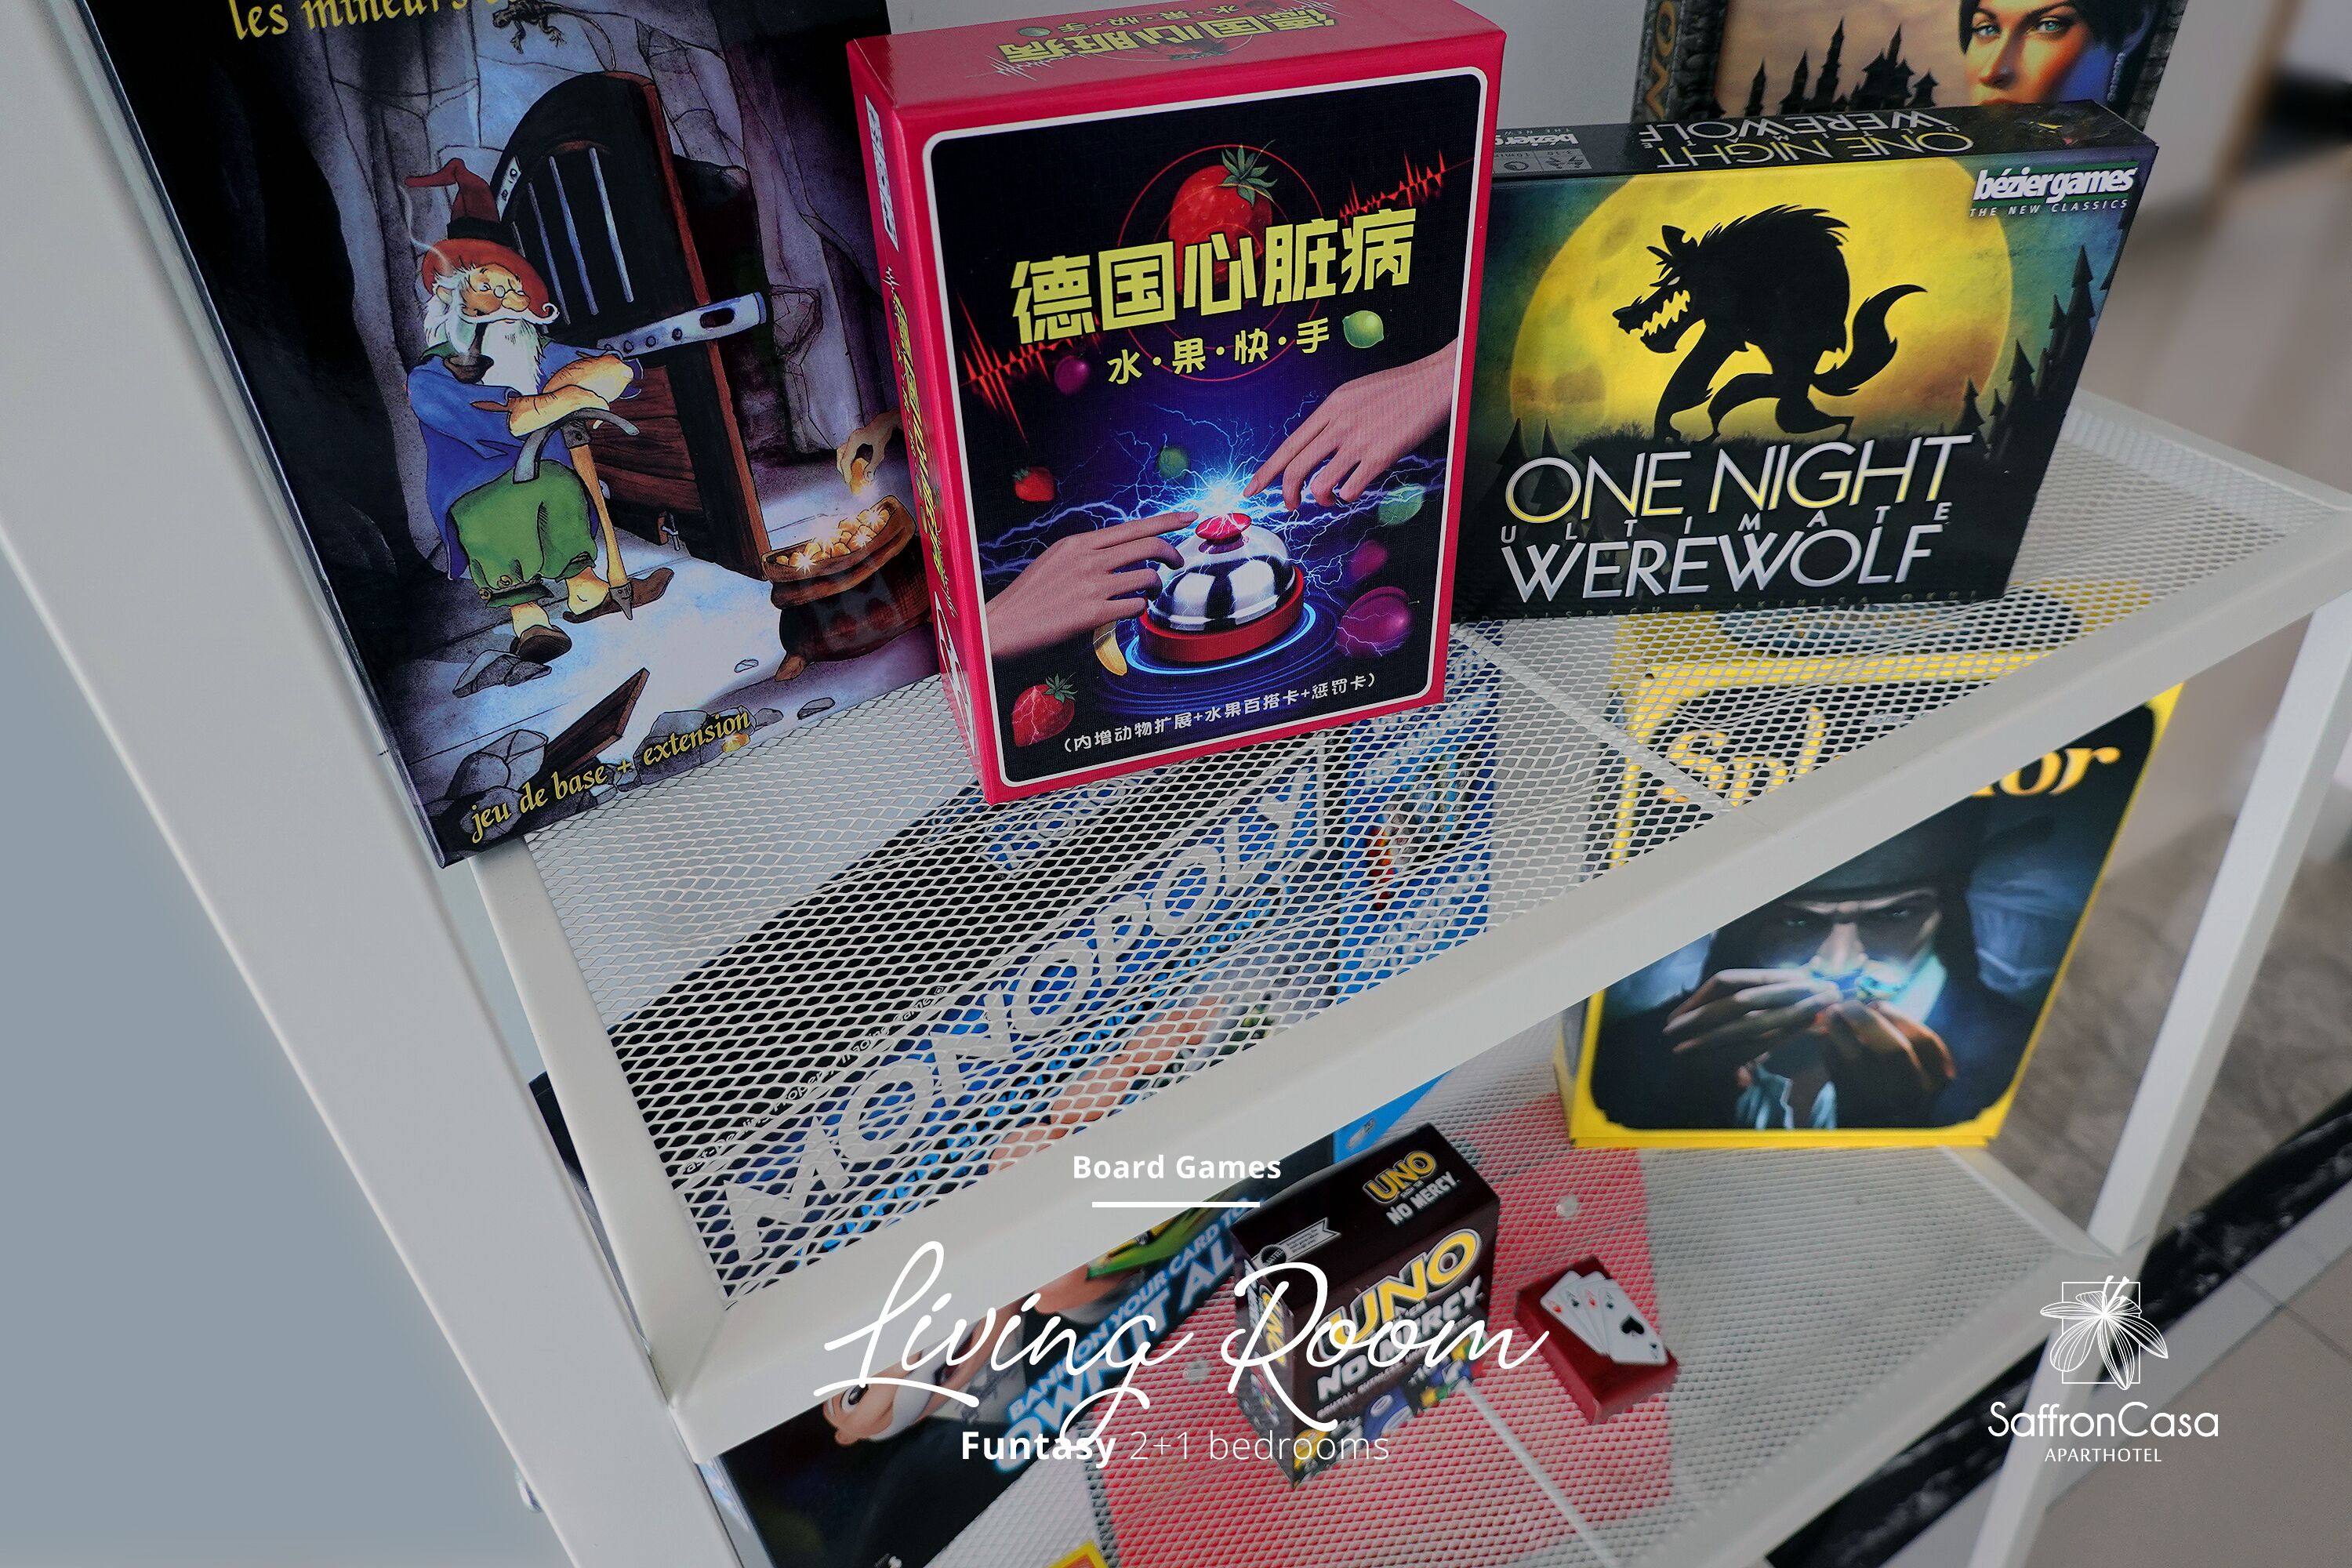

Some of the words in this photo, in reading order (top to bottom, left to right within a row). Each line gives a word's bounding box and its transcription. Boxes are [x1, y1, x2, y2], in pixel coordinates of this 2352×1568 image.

[229, 0, 289, 40] les
[997, 9, 1338, 62] 德国心脏病
[1495, 133, 1579, 147] bézierg
[1639, 111, 1952, 143] WEREWOLF
[1836, 132, 1974, 157] ONE
[1657, 139, 1834, 169] NIGHT
[1969, 207, 1997, 217] THE
[2009, 205, 2041, 216] NEW
[2052, 199, 2129, 212] CLASSICS
[1973, 167, 2138, 204] béziergames
[1011, 209, 1417, 343] 德国心脏病
[1505, 452, 1692, 524] ONE
[1708, 435, 1974, 513] NIGHT
[1501, 502, 1953, 543] ULTIMATE
[1501, 524, 1944, 604] WEREWOLF
[470, 800, 512, 844] jeu
[518, 775, 549, 813] de
[551, 764, 608, 803] base
[617, 759, 633, 775] +
[643, 710, 753, 768] extension
[1363, 1150, 1437, 1203] UNO
[1386, 1203, 1414, 1226] NO
[1411, 1171, 1457, 1209] MERCY
[1074, 1327, 1110, 1361] ON
[1109, 1277, 1169, 1328] YOUR
[1169, 1224, 1221, 1276] CARD
[1316, 1229, 1482, 1360] UNO
[1317, 1354, 1370, 1402] NO
